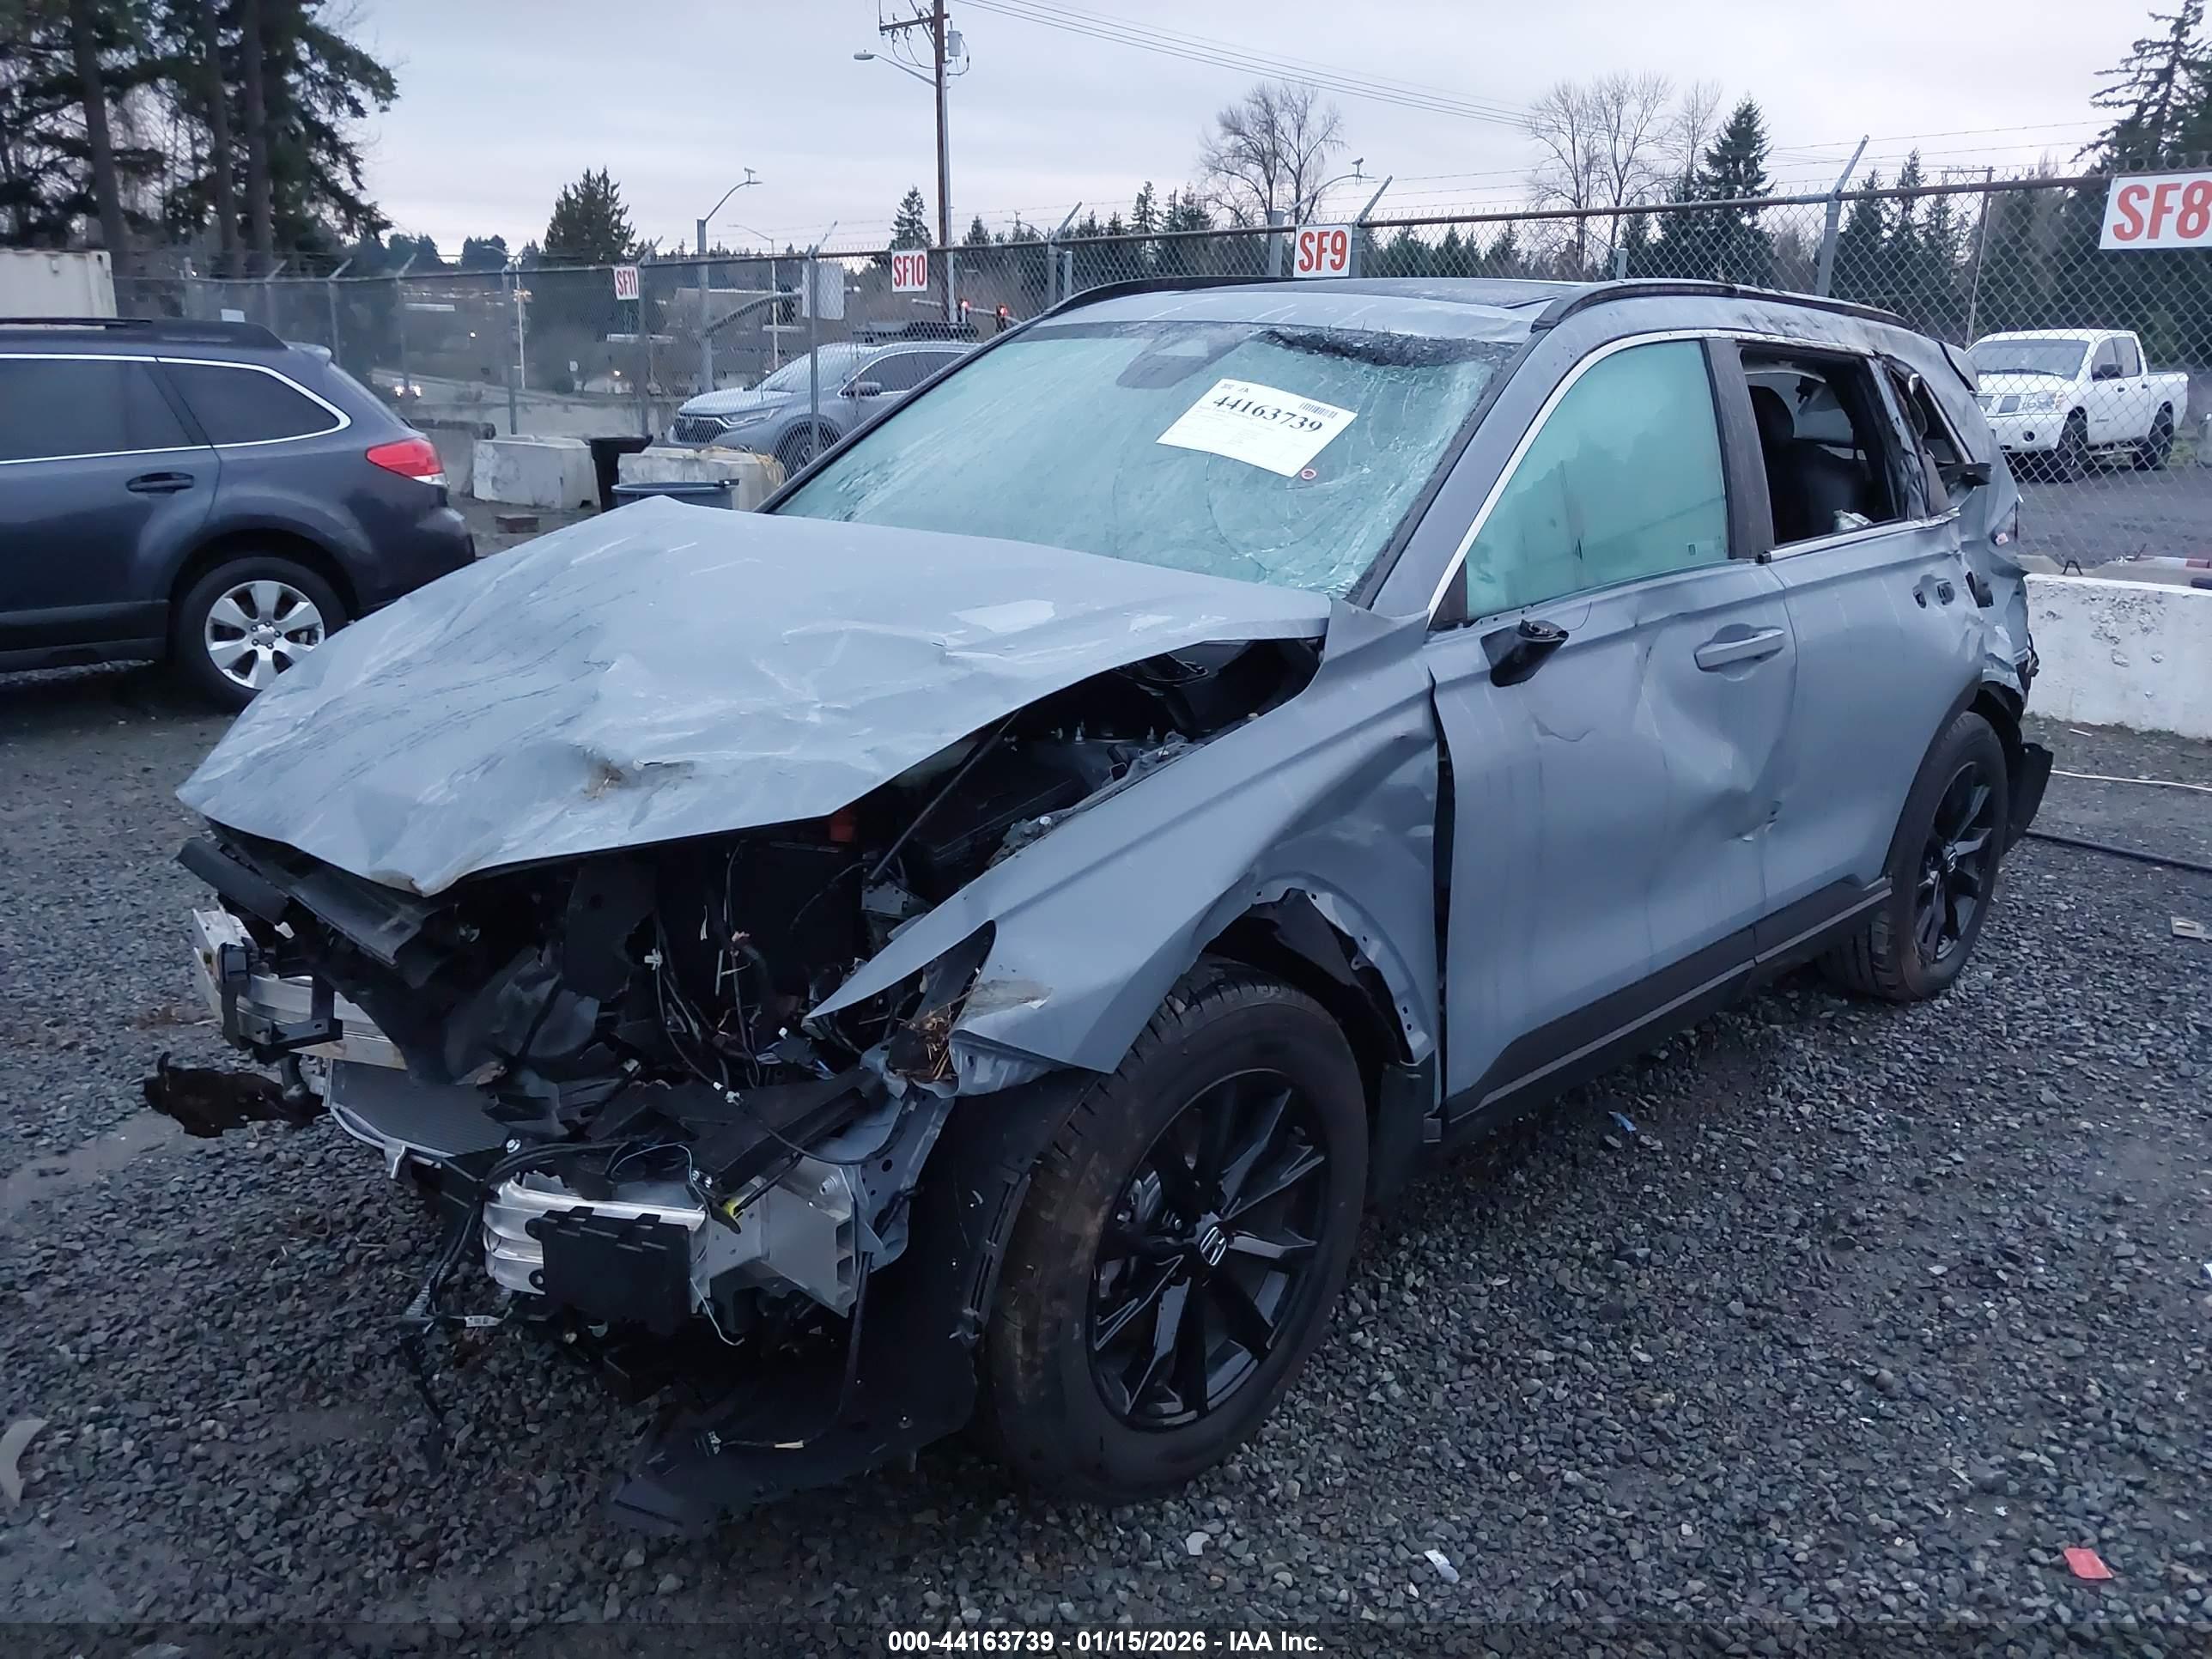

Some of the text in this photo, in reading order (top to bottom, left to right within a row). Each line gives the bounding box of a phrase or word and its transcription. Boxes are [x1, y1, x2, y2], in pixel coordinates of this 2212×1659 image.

[2112, 179, 2212, 242] SF8
[1298, 229, 1347, 272] SF9
[617, 270, 638, 296] SF11
[893, 254, 926, 288] SF10
[1212, 395, 1323, 433] 44163739
